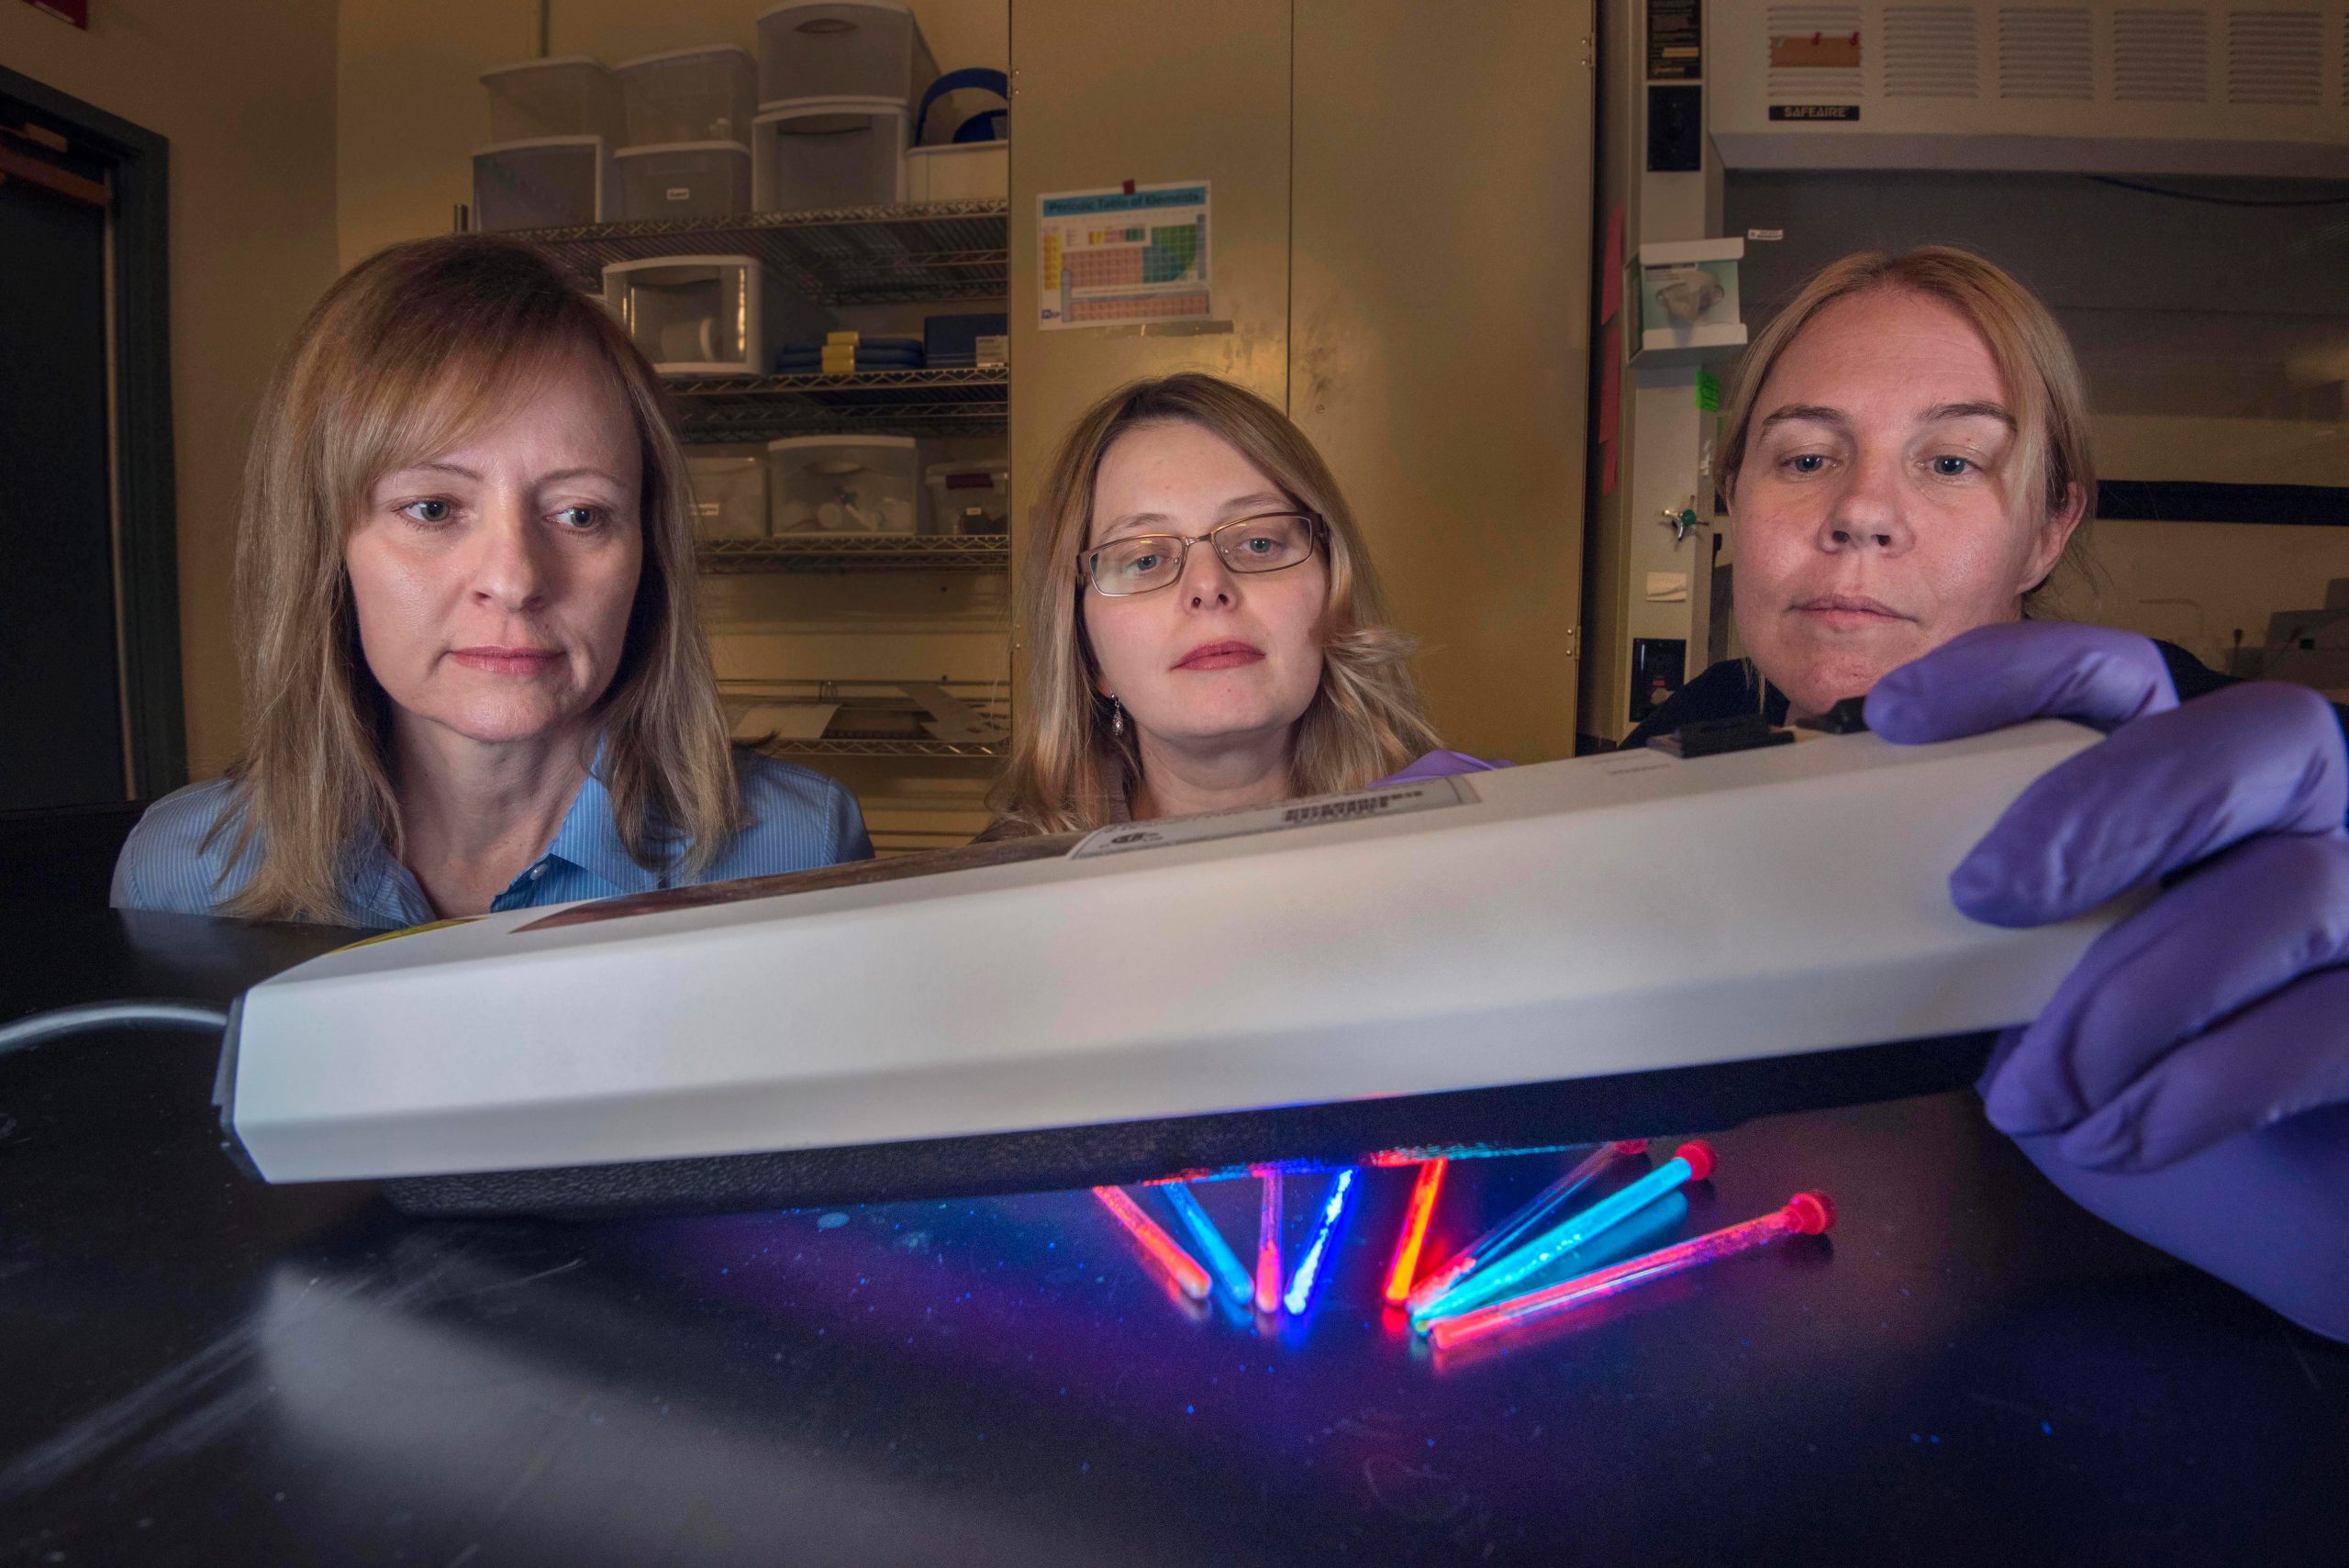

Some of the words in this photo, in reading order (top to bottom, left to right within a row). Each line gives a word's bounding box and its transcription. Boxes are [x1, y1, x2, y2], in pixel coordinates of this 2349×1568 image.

[1784, 106, 1846, 117] SAFEAIRE
[1049, 201, 1094, 212] Periodic
[1097, 198, 1128, 209] Table
[1130, 196, 1142, 206] of
[1146, 193, 1199, 206] Elements
